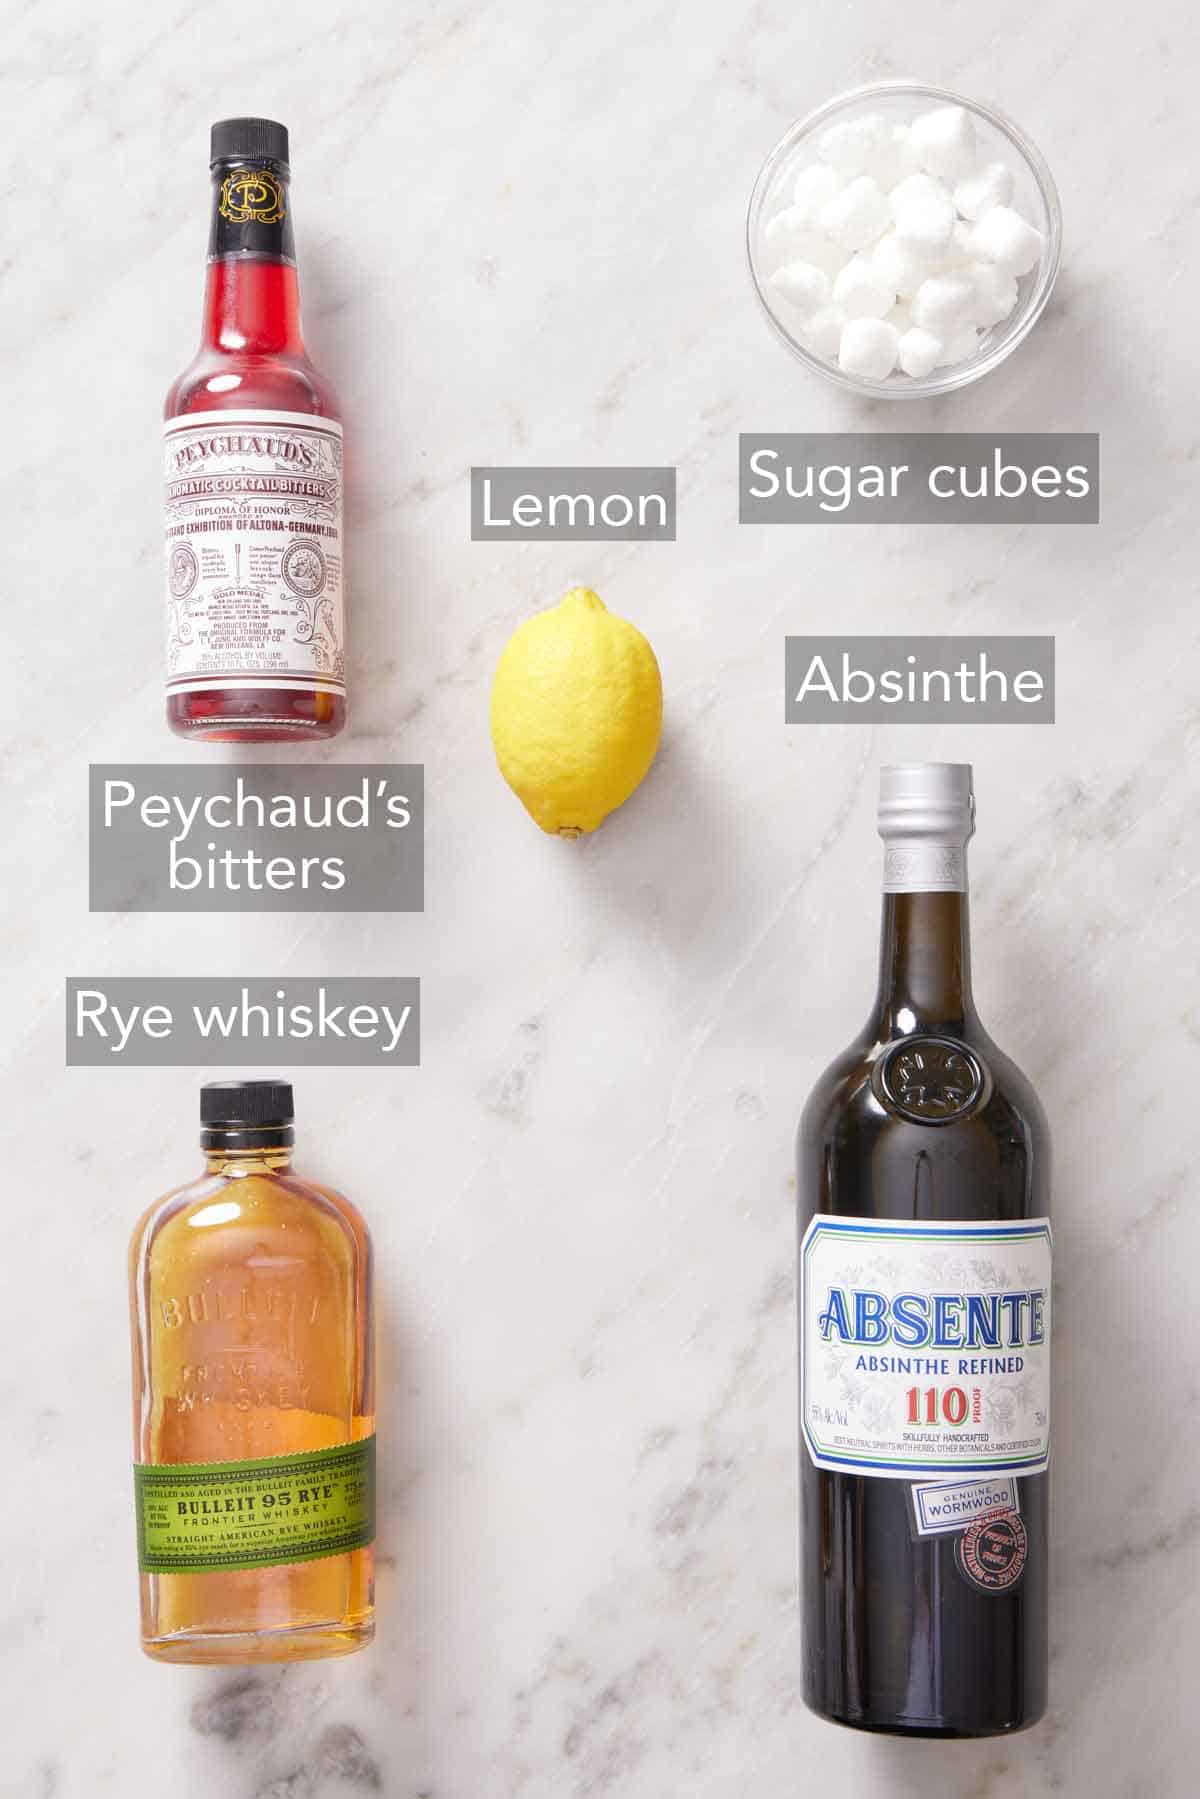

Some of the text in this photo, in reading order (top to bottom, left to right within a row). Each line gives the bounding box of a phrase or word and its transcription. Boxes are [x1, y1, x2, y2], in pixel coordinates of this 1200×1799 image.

[175, 435, 313, 470] PEYCHAUD'S
[213, 478, 278, 493] COCKTAIL
[280, 479, 326, 497] BITTERS
[195, 506, 291, 517] DIPLOMA OF HONOR
[186, 519, 233, 535] EXHIBITION
[236, 520, 248, 531] OF
[818, 1286, 1047, 1350] ABSENTE
[855, 1354, 1025, 1375] ABSINTHE REFINED
[905, 1386, 984, 1426] 110 PROOF
[198, 1487, 221, 1497] AGED
[235, 1484, 254, 1494] THE
[255, 1480, 294, 1492] BULLEIT
[943, 1486, 994, 1502] GENUINE
[177, 1496, 256, 1516] BULLEIT
[262, 1491, 292, 1508] 95
[928, 1491, 1009, 1516] WORMWOOD
[183, 1504, 329, 1527] FRONTIER WHISKEY
[165, 1516, 347, 1545] STRAIGHT AMERICAN RYE WHISKEY
